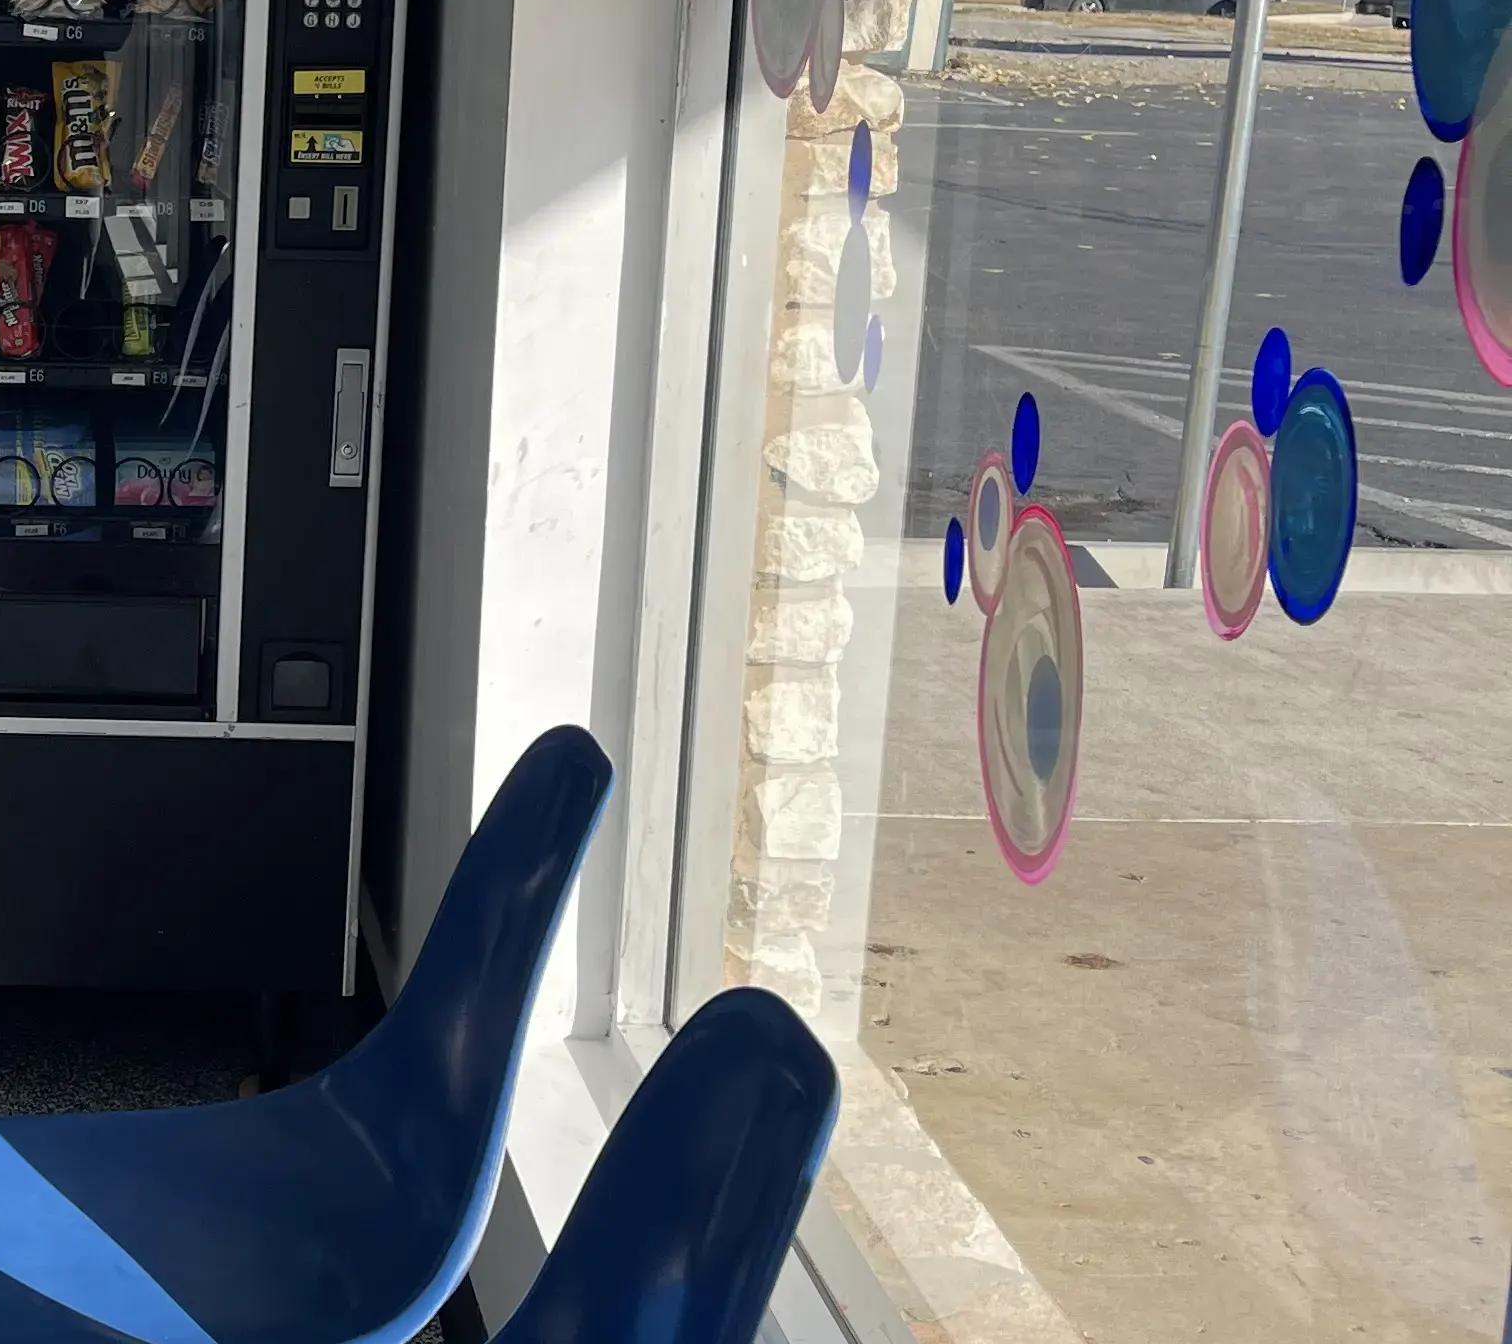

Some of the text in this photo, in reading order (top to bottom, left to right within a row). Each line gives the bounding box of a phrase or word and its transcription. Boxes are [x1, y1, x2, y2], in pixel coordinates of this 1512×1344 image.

[66, 25, 83, 40] C6
[188, 27, 205, 41] C8
[1, 109, 35, 184] TWIX
[29, 200, 46, 213] D6
[29, 369, 44, 383] E6
[153, 371, 168, 385] E8
